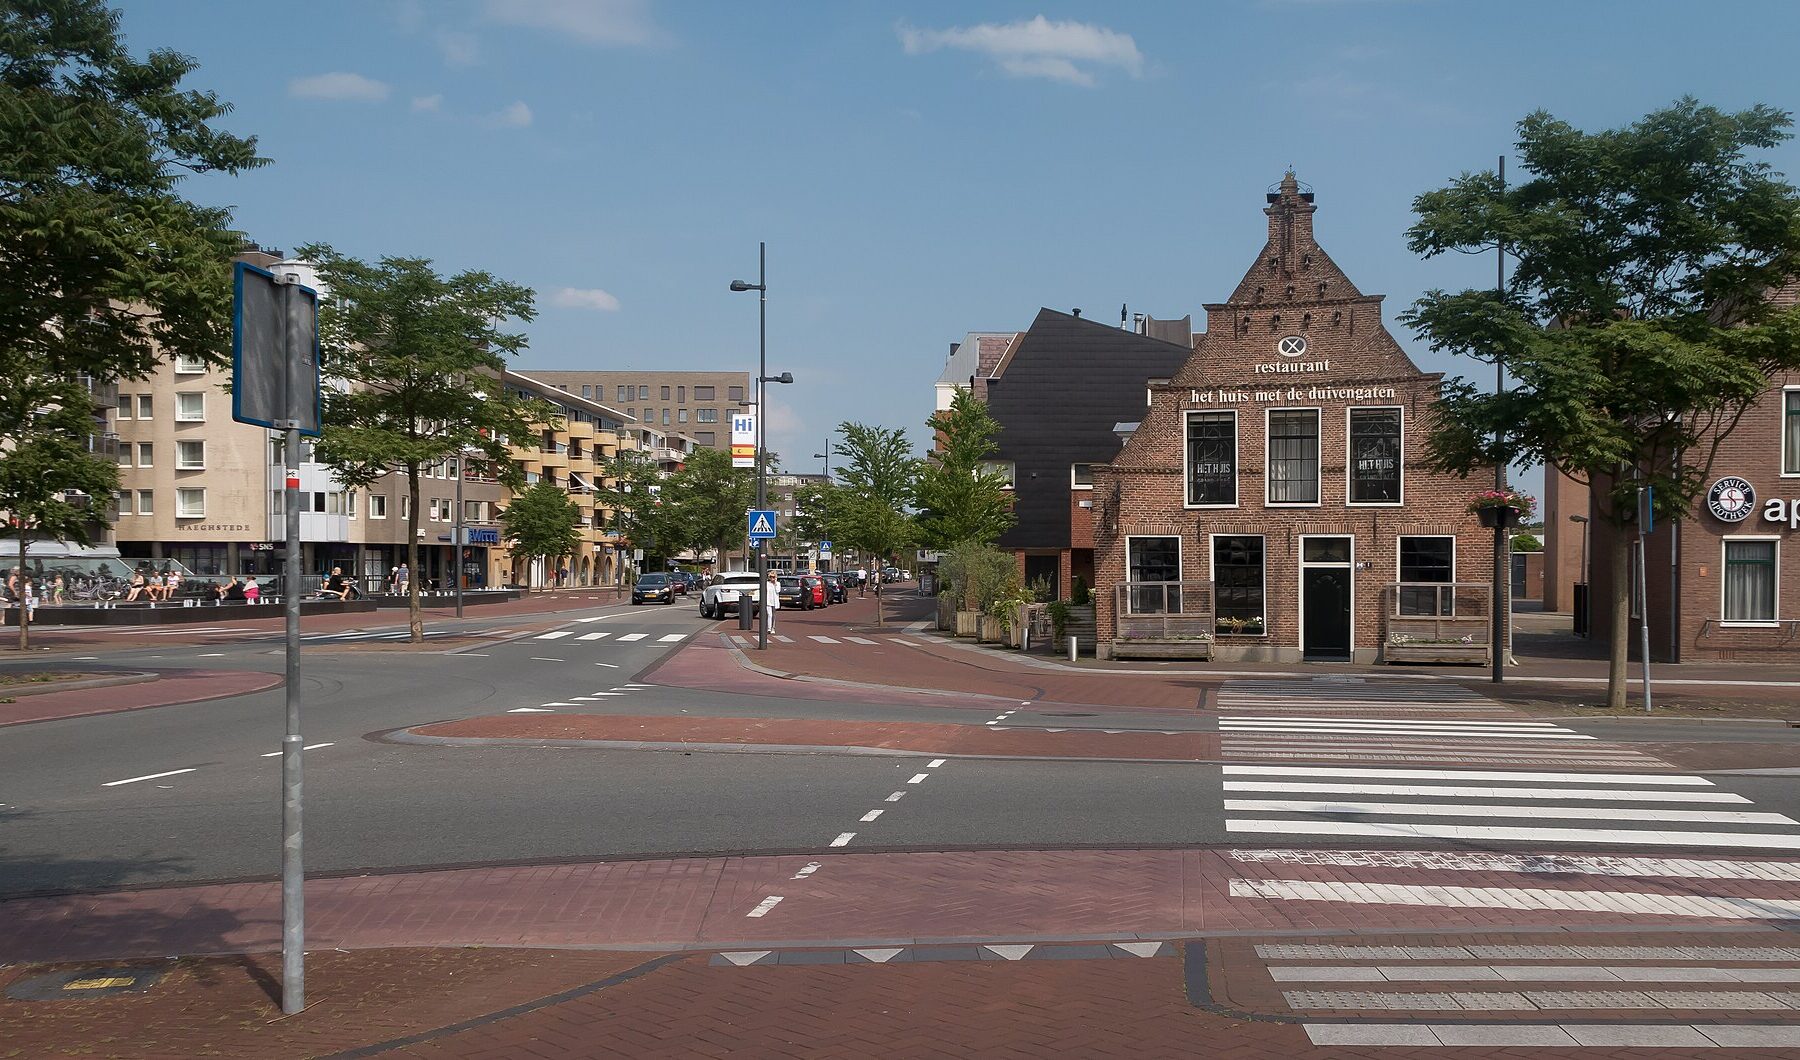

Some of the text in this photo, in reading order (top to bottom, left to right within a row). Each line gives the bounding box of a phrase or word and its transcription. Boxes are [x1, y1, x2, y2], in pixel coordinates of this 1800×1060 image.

[1254, 359, 1330, 373] restaurant
[1190, 386, 1396, 403] het huis met de duivengaten
[735, 417, 752, 431] Hi
[1714, 479, 1750, 495] SERVICE
[1710, 500, 1753, 519] APOTHEEK
